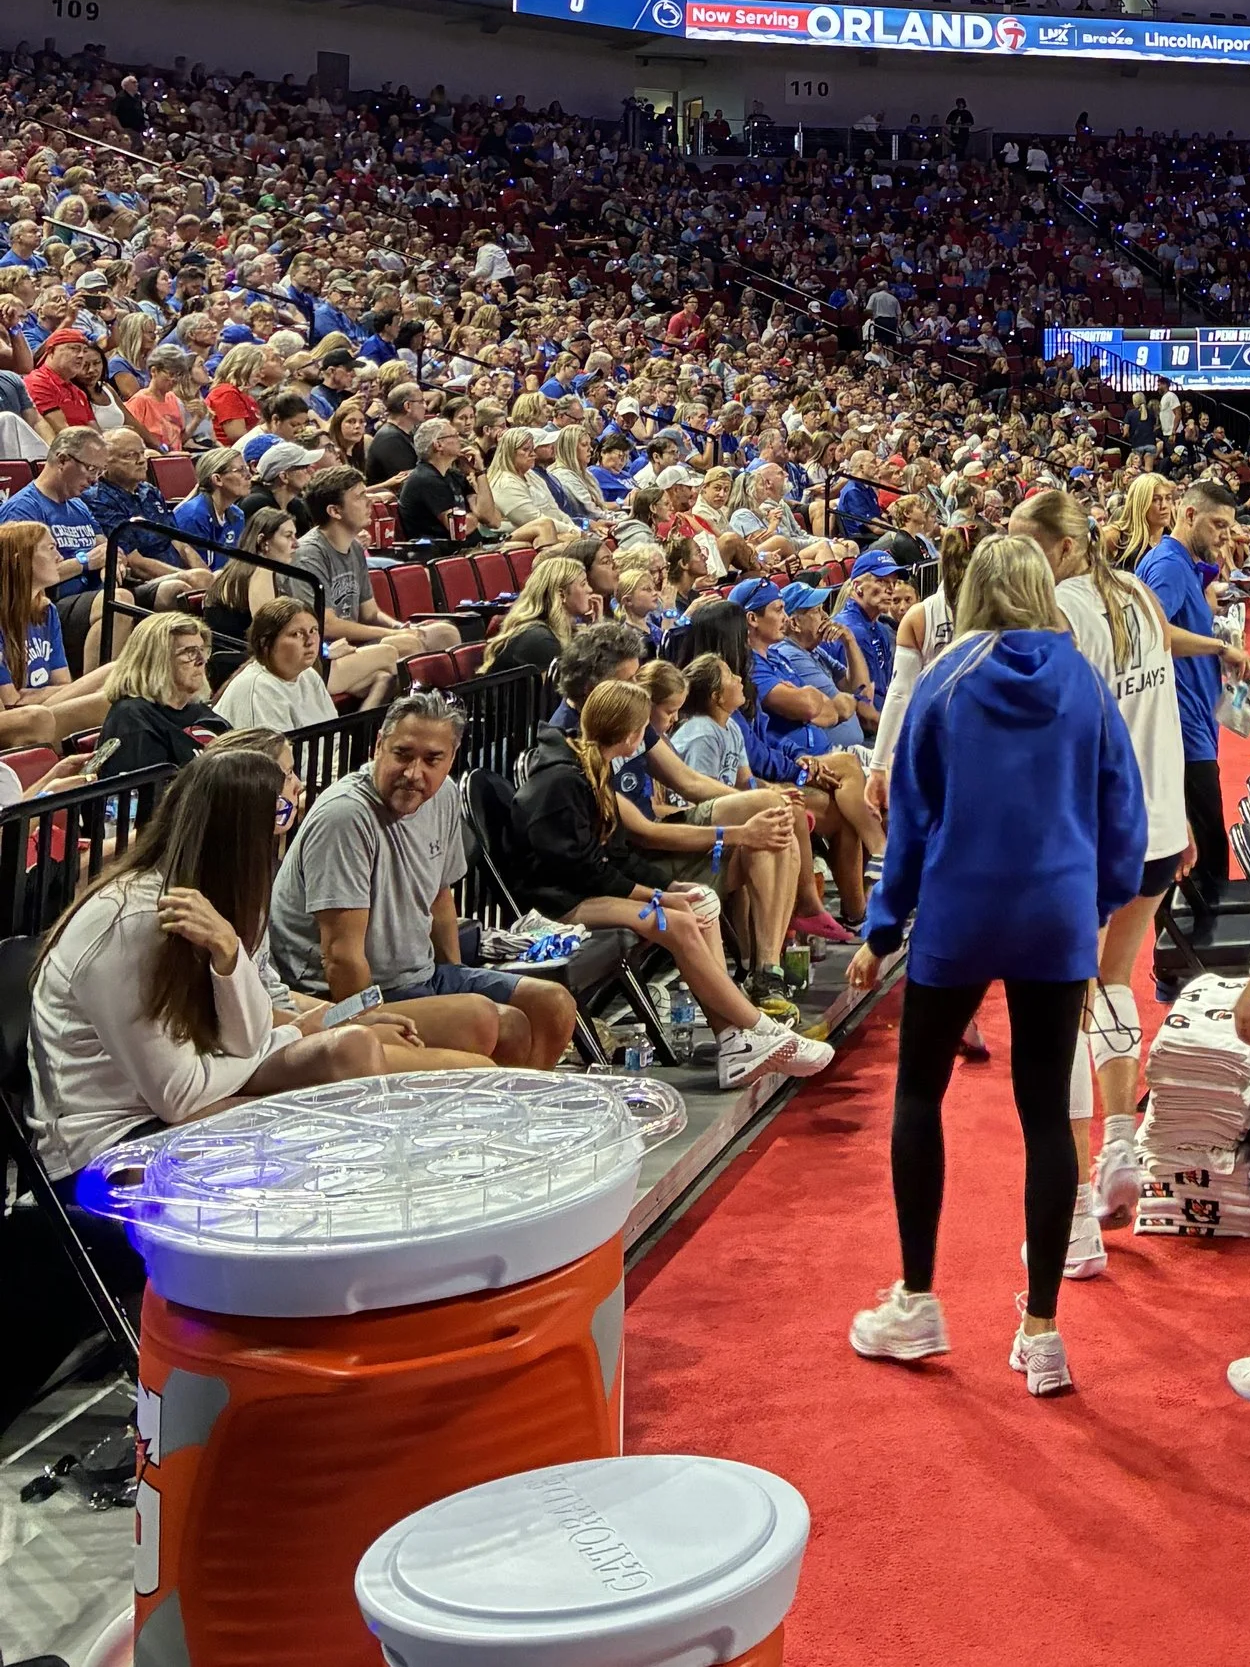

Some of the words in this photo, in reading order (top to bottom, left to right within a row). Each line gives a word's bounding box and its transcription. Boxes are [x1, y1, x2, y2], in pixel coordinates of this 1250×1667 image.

[692, 7, 732, 24] Now
[735, 10, 799, 30] Serving
[1083, 33, 1134, 45] Breeze
[790, 80, 829, 97] 110
[1215, 330, 1238, 341] PENN
[1136, 346, 1148, 366] 9
[1172, 345, 1190, 366] 10
[521, 1472, 655, 1593] GATORADE
